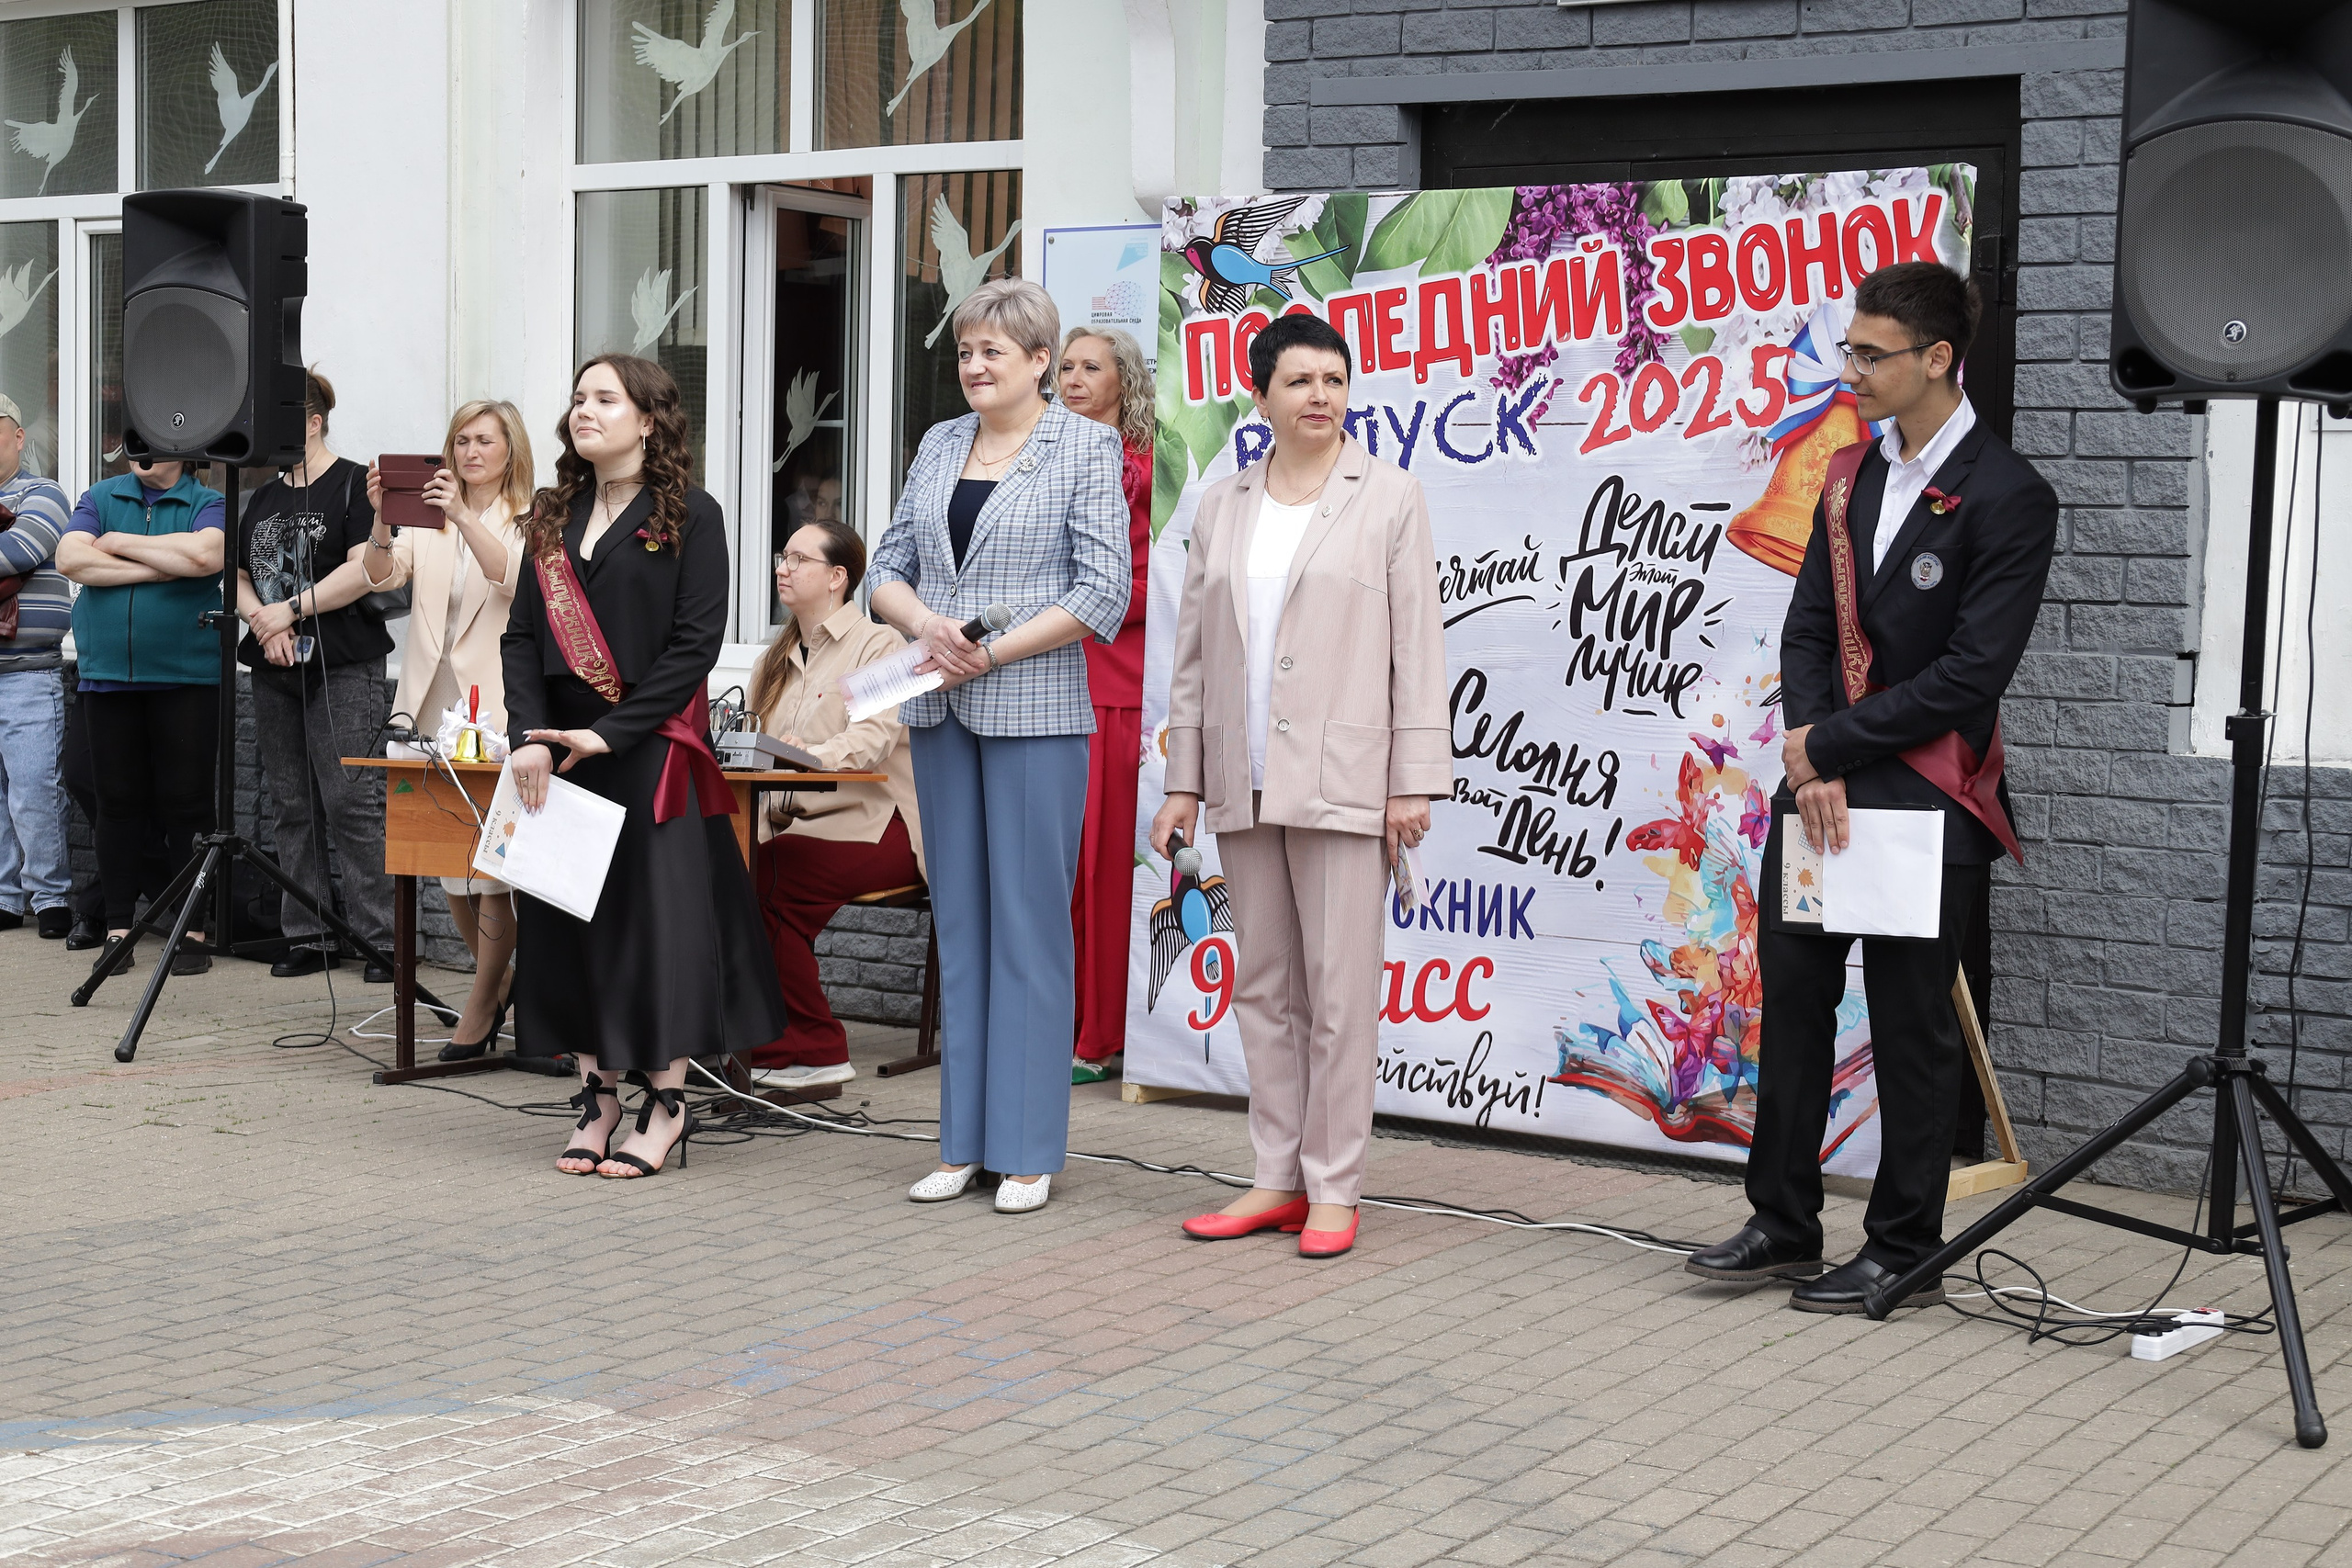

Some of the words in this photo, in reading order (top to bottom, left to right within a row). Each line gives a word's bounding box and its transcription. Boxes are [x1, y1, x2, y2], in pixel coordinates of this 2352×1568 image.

[1647, 193, 1943, 327] ЗВОНОК
[1577, 344, 1796, 455] 2025
[1436, 535, 1546, 604] ечтай
[1559, 475, 1731, 583] Делай
[1569, 565, 1705, 660] Мир
[1449, 668, 1620, 809] Сегодня
[483, 818, 498, 854] классы
[1188, 937, 1236, 1031] 9
